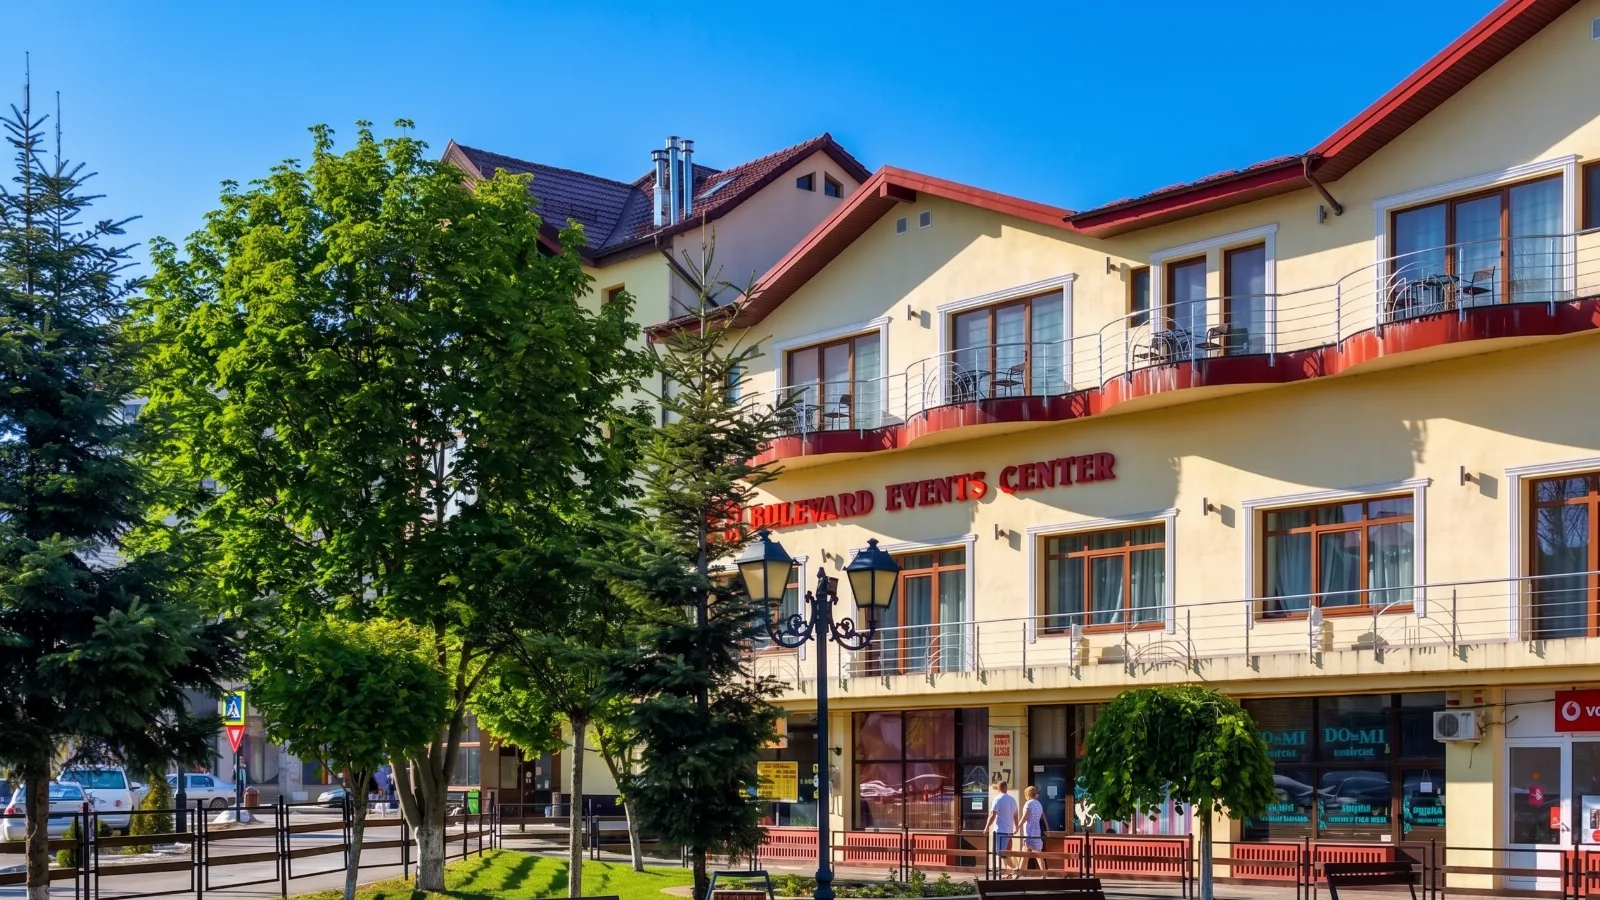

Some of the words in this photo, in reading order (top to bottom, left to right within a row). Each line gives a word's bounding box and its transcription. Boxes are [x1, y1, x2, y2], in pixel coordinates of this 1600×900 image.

[749, 489, 874, 532] BULEVARD
[885, 471, 988, 512] EVENTS
[999, 452, 1117, 494] CENTER
